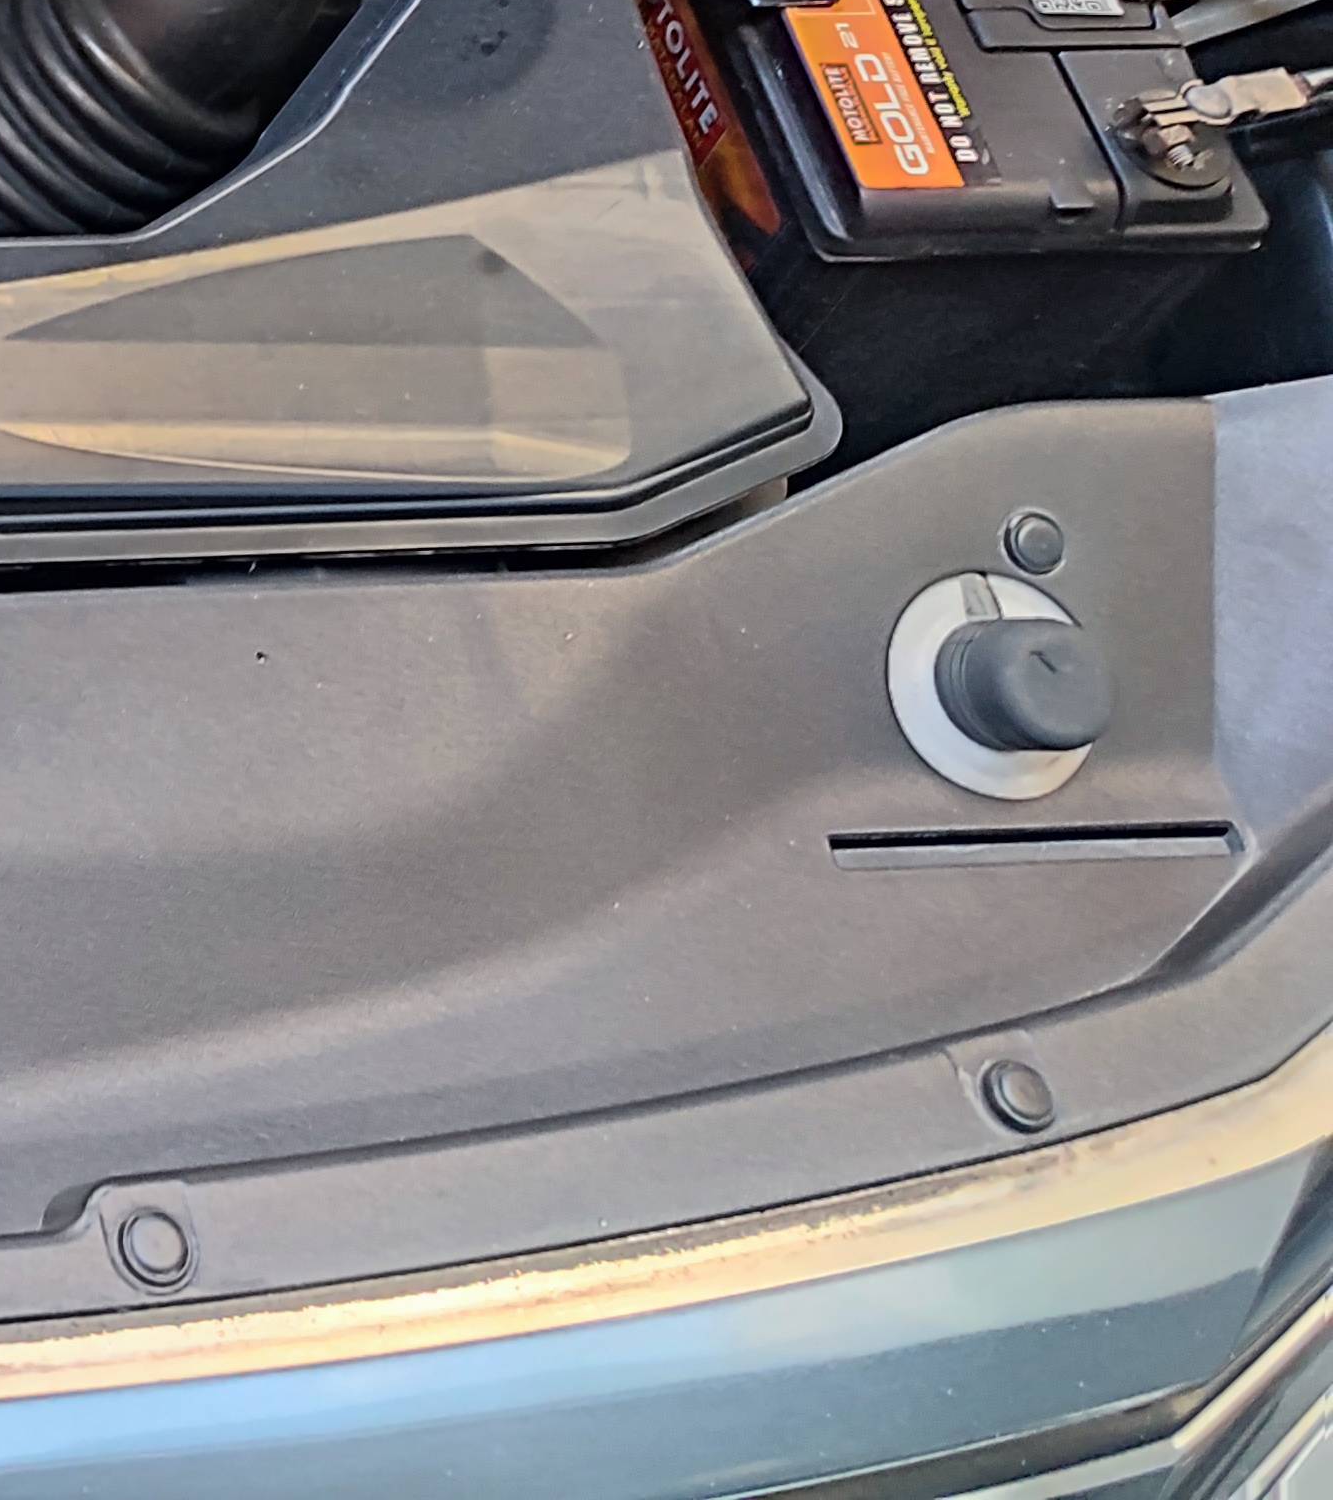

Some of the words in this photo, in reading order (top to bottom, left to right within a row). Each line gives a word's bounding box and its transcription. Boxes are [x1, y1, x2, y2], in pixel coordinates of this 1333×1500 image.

[835, 23, 859, 49] 21
[891, 11, 944, 84] REMOVE
[824, 65, 871, 142] MOTOLITE
[854, 53, 929, 175] GOLD
[927, 91, 963, 129] NOT
[949, 135, 979, 162] DO
